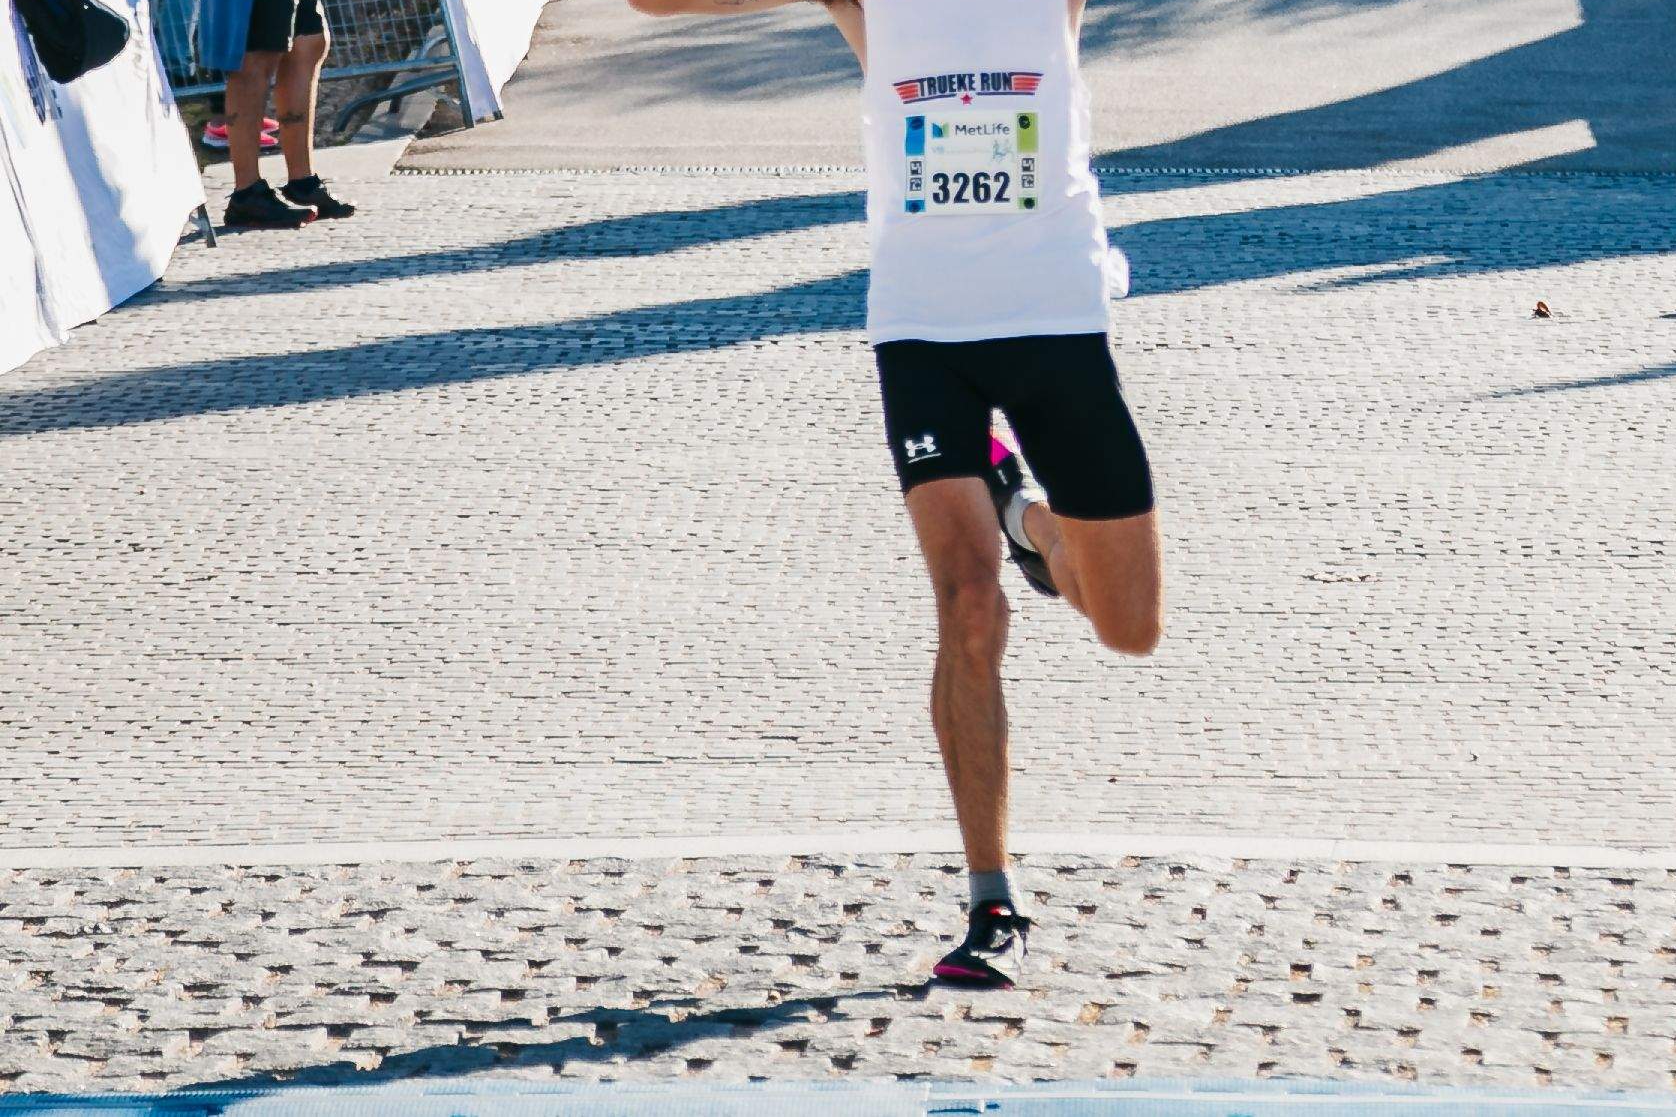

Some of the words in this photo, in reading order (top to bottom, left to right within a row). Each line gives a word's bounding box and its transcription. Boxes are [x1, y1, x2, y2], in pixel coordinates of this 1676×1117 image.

[919, 73, 975, 96] TRUEKE
[980, 72, 1012, 91] RUN
[955, 123, 1010, 135] MetLife
[932, 172, 1010, 204] 3262
